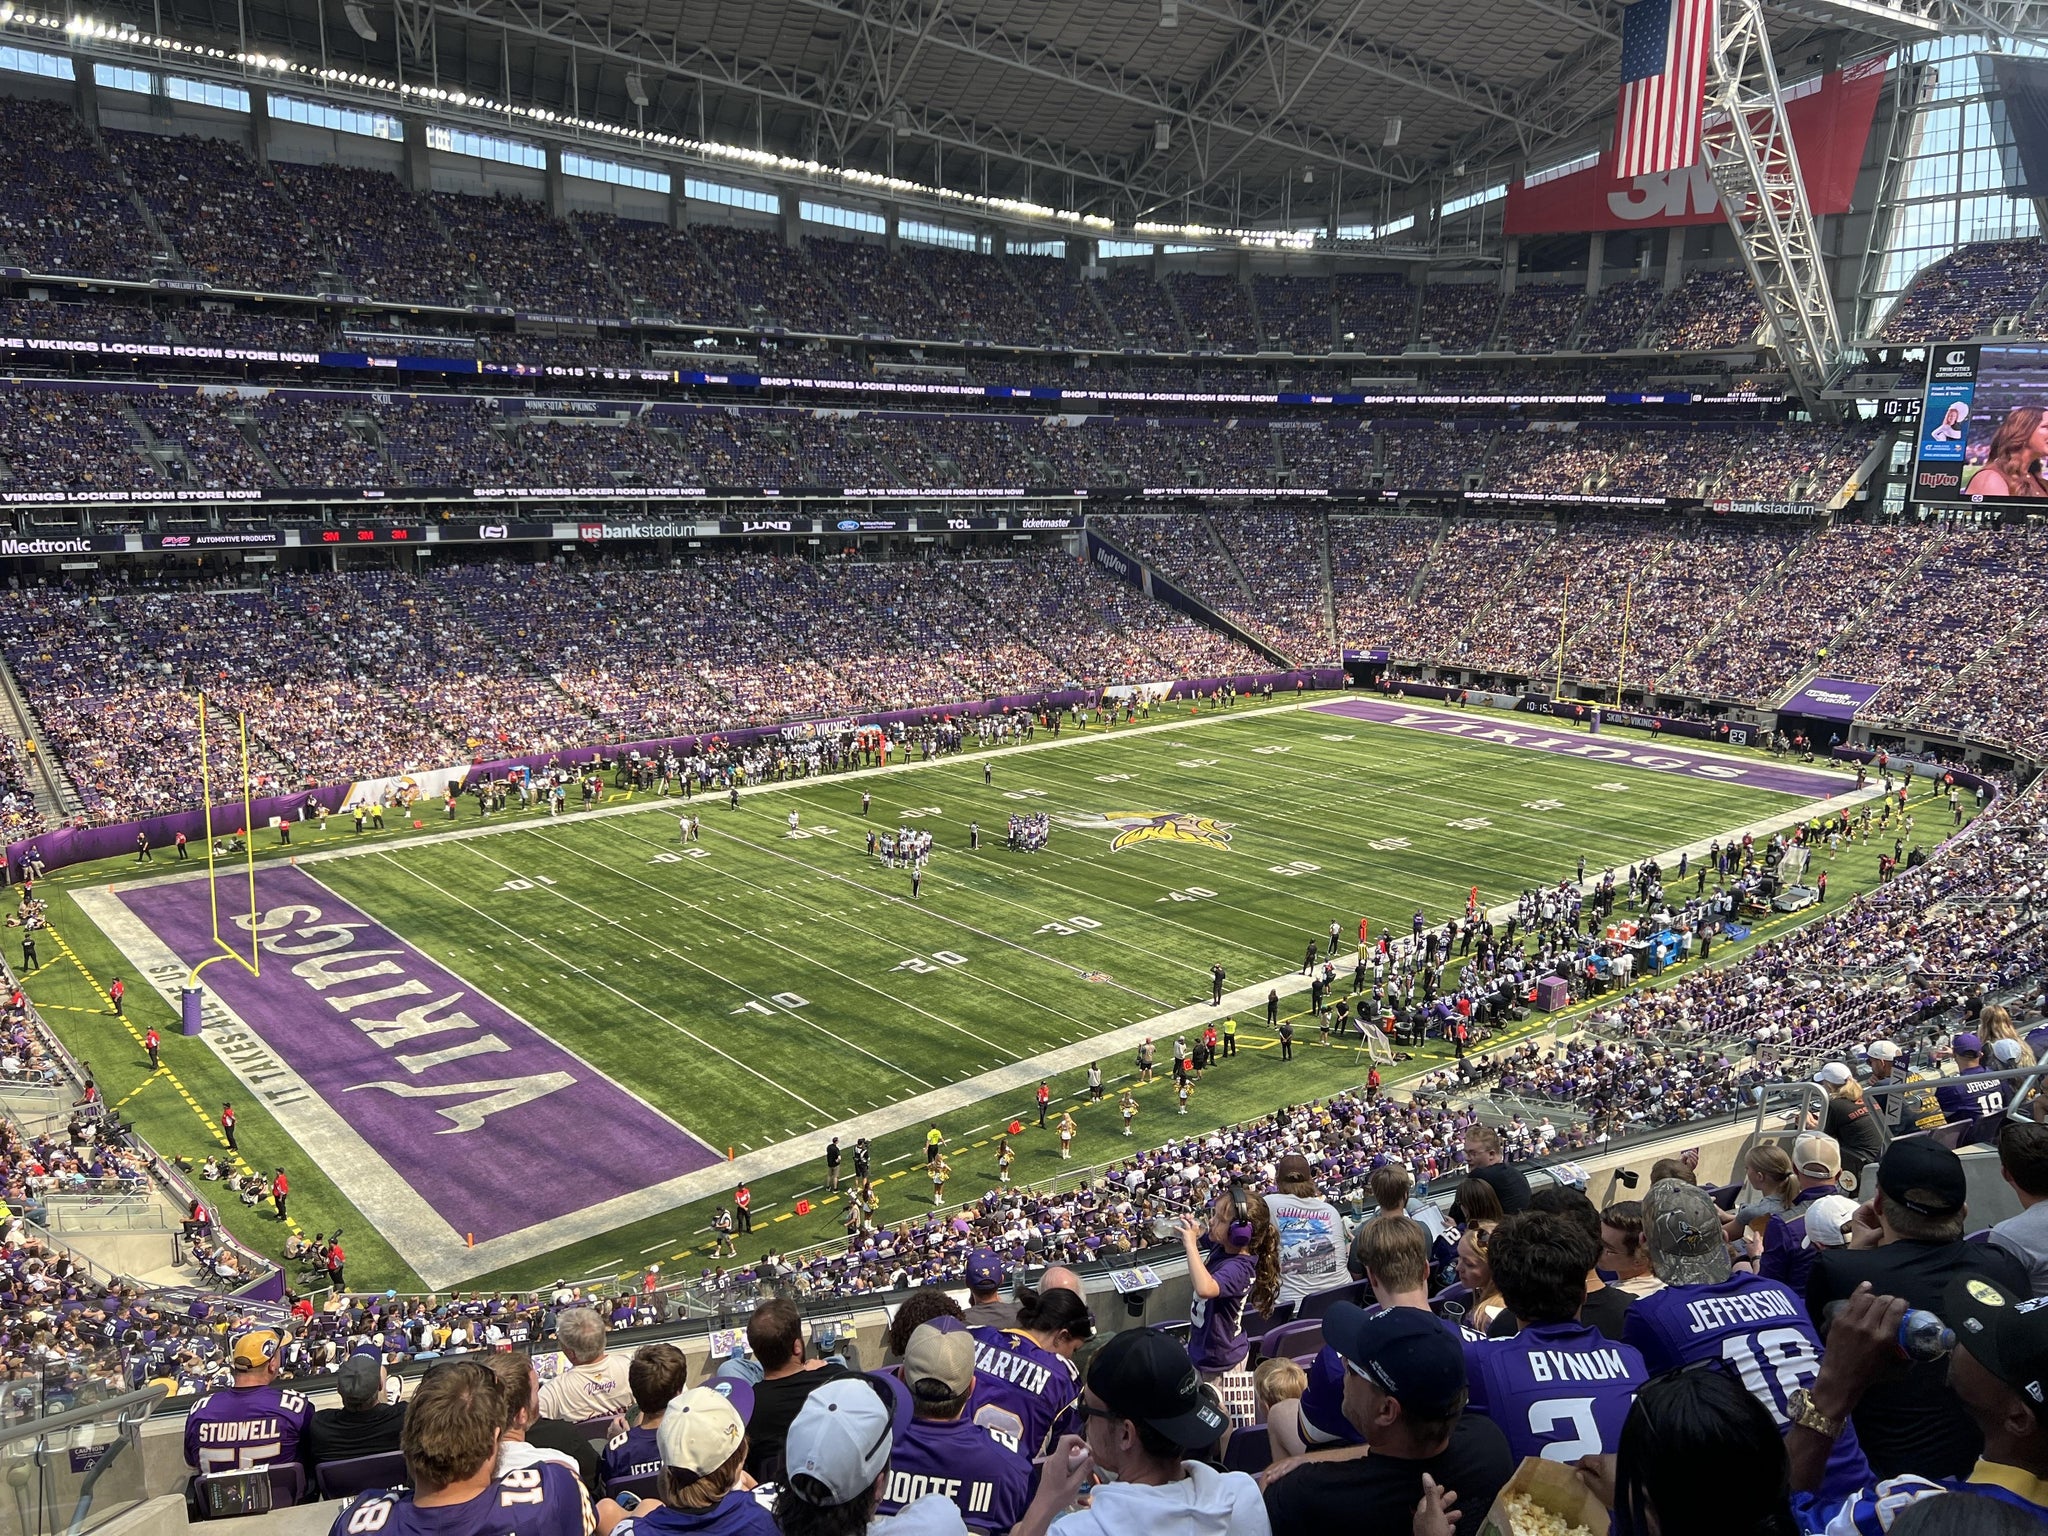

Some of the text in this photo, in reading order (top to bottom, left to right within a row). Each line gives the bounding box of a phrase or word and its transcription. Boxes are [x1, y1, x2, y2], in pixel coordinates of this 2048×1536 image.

[1606, 142, 1748, 221] 3M
[27, 338, 98, 351] VIKINGS
[102, 343, 171, 355] LOCKER
[174, 347, 222, 358] ROOM
[225, 350, 278, 361] STORE
[280, 353, 319, 363] NOW!
[545, 367, 584, 377] 10:15
[761, 377, 985, 395] SHOP THE VIKINGS LOCKER ROOM STORE NOW!
[371, 393, 394, 405] SKOL
[1062, 390, 1087, 398] SHOP
[1089, 391, 1106, 399] THE
[1108, 392, 1145, 400] VIKINGS
[1147, 393, 1185, 401] LOCKER
[1217, 394, 1250, 402] STORE
[1396, 396, 1416, 404] THE
[1418, 396, 1459, 404] VIKINGS
[1461, 396, 1505, 404] LOCKER
[1506, 395, 1539, 403] ROOM
[1540, 395, 1576, 403] STORE
[525, 400, 597, 411] MINNESOTA VIKINGS
[1884, 401, 1921, 414] 10:15
[3, 490, 261, 501] VIKINGS LOCKER ROOM STORE NOW!
[474, 488, 505, 496] SHOP
[506, 488, 528, 496] THE
[529, 488, 570, 496] VIKINGS
[919, 488, 951, 496] LOCKER
[953, 488, 976, 496] ROOM
[978, 488, 1003, 496] STORE
[742, 521, 792, 532] LUND
[948, 519, 971, 529] TCL
[1022, 518, 1071, 529] ticketmaster
[197, 534, 276, 544] AUTOMOTIVE PRODUCTS
[323, 531, 340, 542] 3M
[357, 530, 374, 541] 3M
[391, 529, 407, 540] 3M
[1, 537, 92, 554] Medtronic
[1816, 696, 1861, 707] stadium
[1606, 712, 1624, 723] SKOL
[815, 720, 851, 737] VIKINGS
[1391, 711, 1749, 779] VIKINGS
[1731, 731, 1745, 743] 25
[1368, 837, 1412, 850] 40
[654, 847, 712, 863] 20
[1267, 861, 1322, 877] 50
[504, 875, 557, 891] 10
[1168, 886, 1219, 902] 40
[1042, 916, 1103, 936] 30
[900, 950, 969, 974] 20
[149, 964, 187, 983] US
[745, 992, 811, 1016] 10
[230, 904, 578, 1136] VIKINGS
[213, 1032, 286, 1085] TAKES
[1894, 1059, 1906, 1068] 240
[1966, 1078, 2001, 1094] JEFFERSON
[264, 1086, 312, 1107] IT
[1686, 1290, 1798, 1334] JEFFERSON
[1528, 1348, 1630, 1383] BYNUM
[1722, 1327, 1821, 1425] 18
[583, 1380, 616, 1395] Vikings
[199, 1419, 281, 1443] STUDWELL
[74, 1445, 105, 1455] CAUTION
[199, 1442, 281, 1475] 55
[968, 1481, 993, 1513] III
